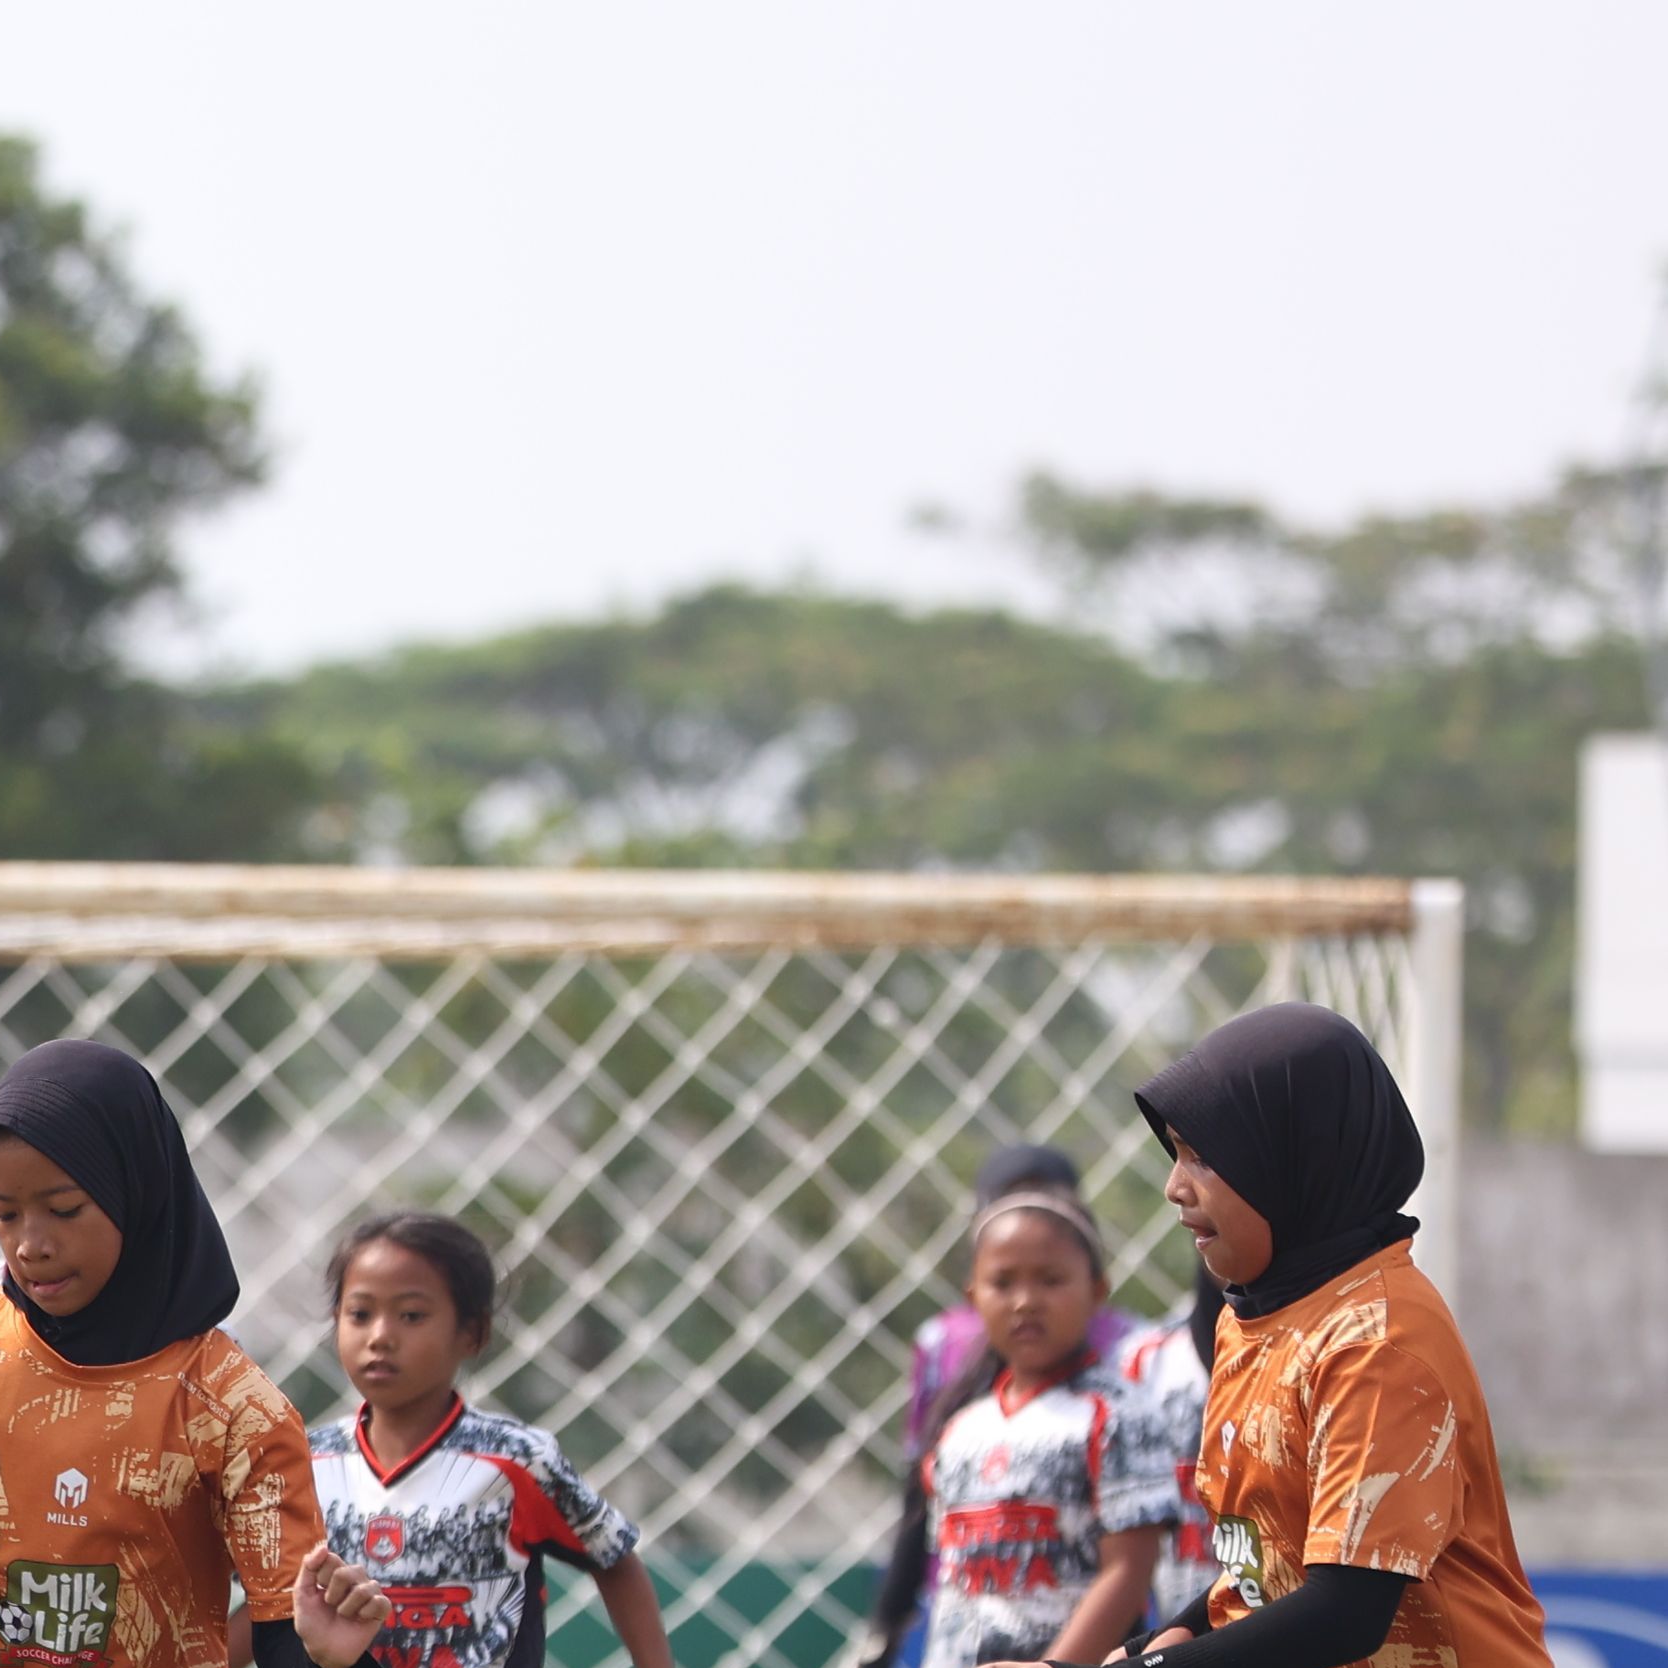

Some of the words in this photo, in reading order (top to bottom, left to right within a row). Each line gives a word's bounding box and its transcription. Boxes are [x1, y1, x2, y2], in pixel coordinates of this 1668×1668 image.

[46, 1512, 88, 1527] MILLS
[21, 1571, 107, 1614] Milk
[34, 1611, 105, 1652] Life
[16, 1648, 51, 1661] SOCCER
